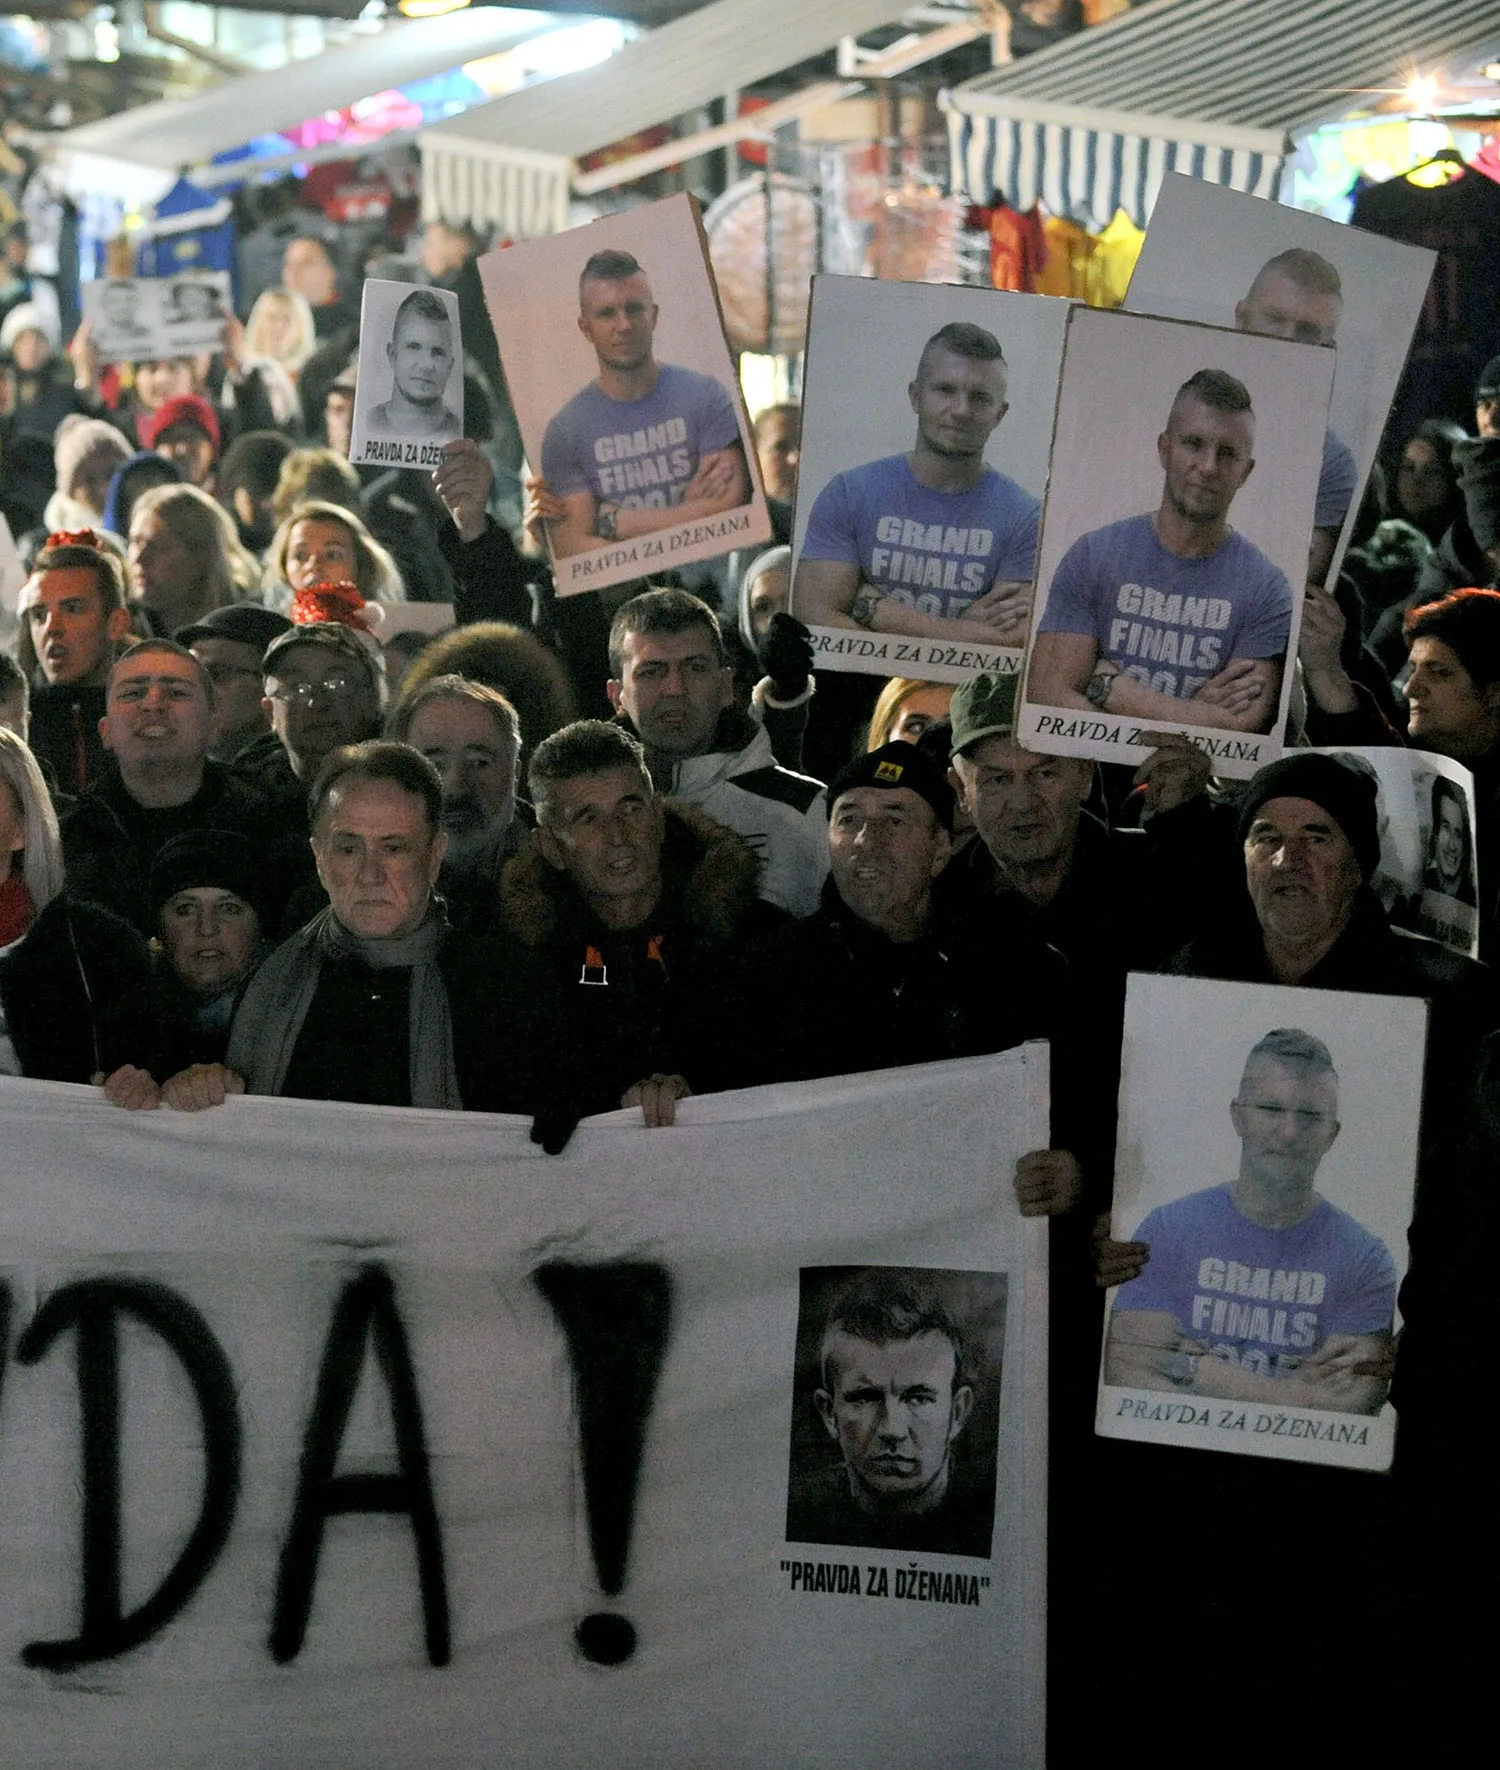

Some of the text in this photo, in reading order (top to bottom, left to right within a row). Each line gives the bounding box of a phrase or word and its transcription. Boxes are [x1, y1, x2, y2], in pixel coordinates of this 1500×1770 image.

[404, 445, 418, 463] ZA
[594, 417, 687, 462] GRAND
[597, 449, 691, 494] FINALS
[571, 514, 750, 578] PRAVDA ZA DŽENANA
[876, 516, 994, 556] GRAND
[871, 548, 986, 592] FINALS
[1116, 583, 1233, 630] GRAND
[895, 645, 920, 662] ZA
[1109, 618, 1223, 670] FINALS
[1036, 716, 1121, 743] PRAVDA
[1126, 727, 1144, 747] Z
[1197, 1257, 1327, 1306] GRAND
[1192, 1295, 1318, 1348] FINALS
[1116, 1398, 1369, 1446] PRAVDA ZA DŽENANA
[780, 1560, 990, 1606] "PRAVDA ZA DŽENANA"
